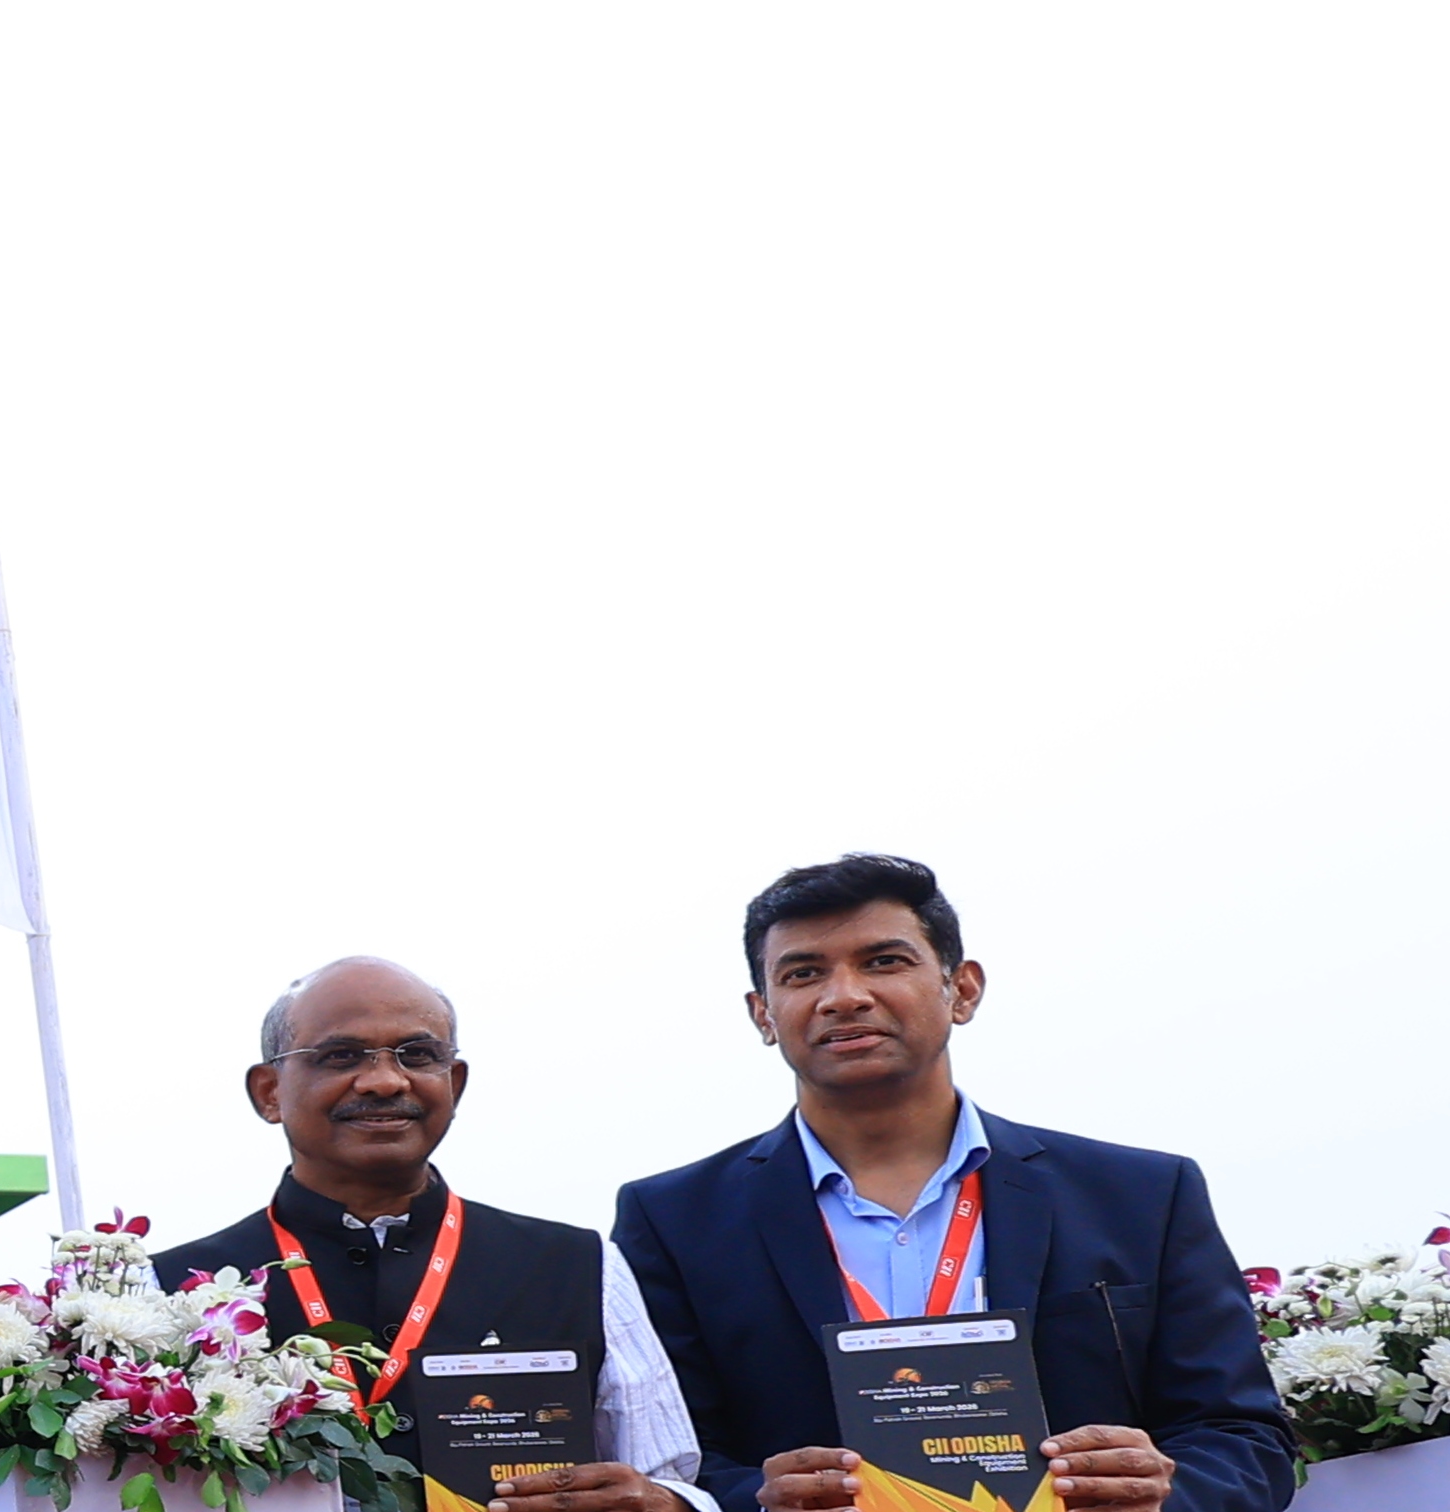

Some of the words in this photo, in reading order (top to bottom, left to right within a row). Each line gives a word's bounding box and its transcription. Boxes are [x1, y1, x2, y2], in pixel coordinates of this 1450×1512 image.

[957, 1199, 973, 1218] CII
[431, 1256, 446, 1273] CII
[939, 1257, 956, 1277] CII
[309, 1301, 326, 1318] CII
[409, 1305, 426, 1323] CII
[332, 1358, 349, 1375] CII
[384, 1358, 400, 1378] CII
[922, 1438, 950, 1455] CII
[951, 1434, 1025, 1455] ODISHA
[490, 1464, 512, 1481] CII
